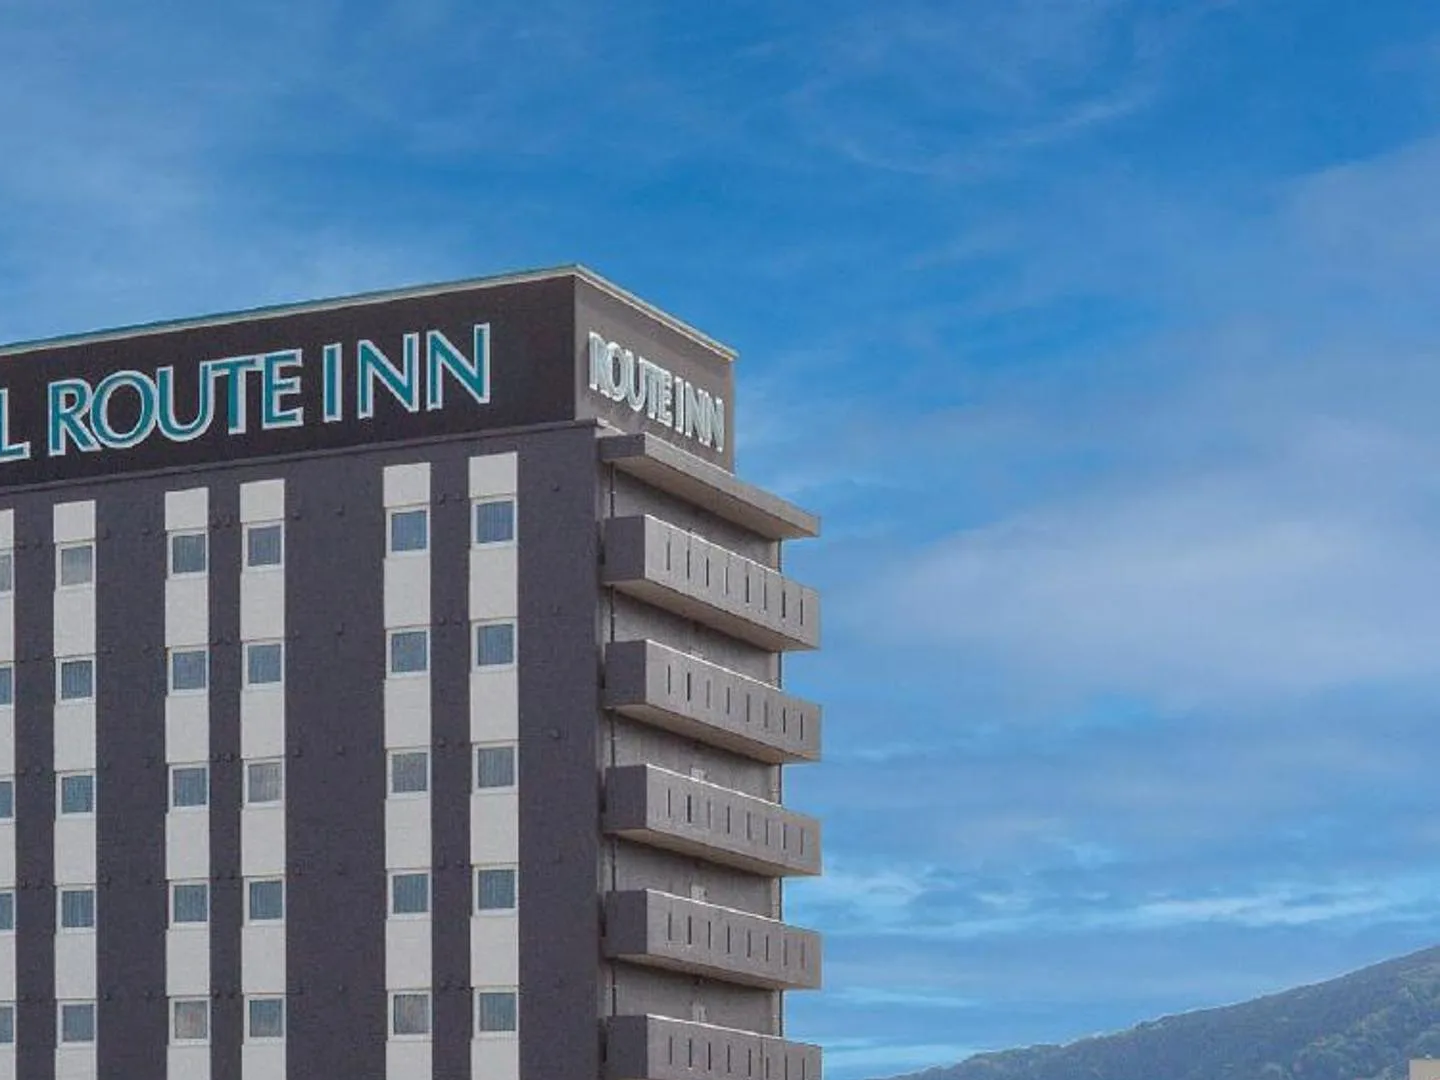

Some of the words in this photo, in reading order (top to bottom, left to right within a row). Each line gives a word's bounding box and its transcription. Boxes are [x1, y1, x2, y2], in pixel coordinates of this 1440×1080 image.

[48, 348, 304, 457] ROUTE
[323, 322, 490, 423] INN
[588, 331, 673, 427] ROUTE
[674, 376, 725, 452] INN
